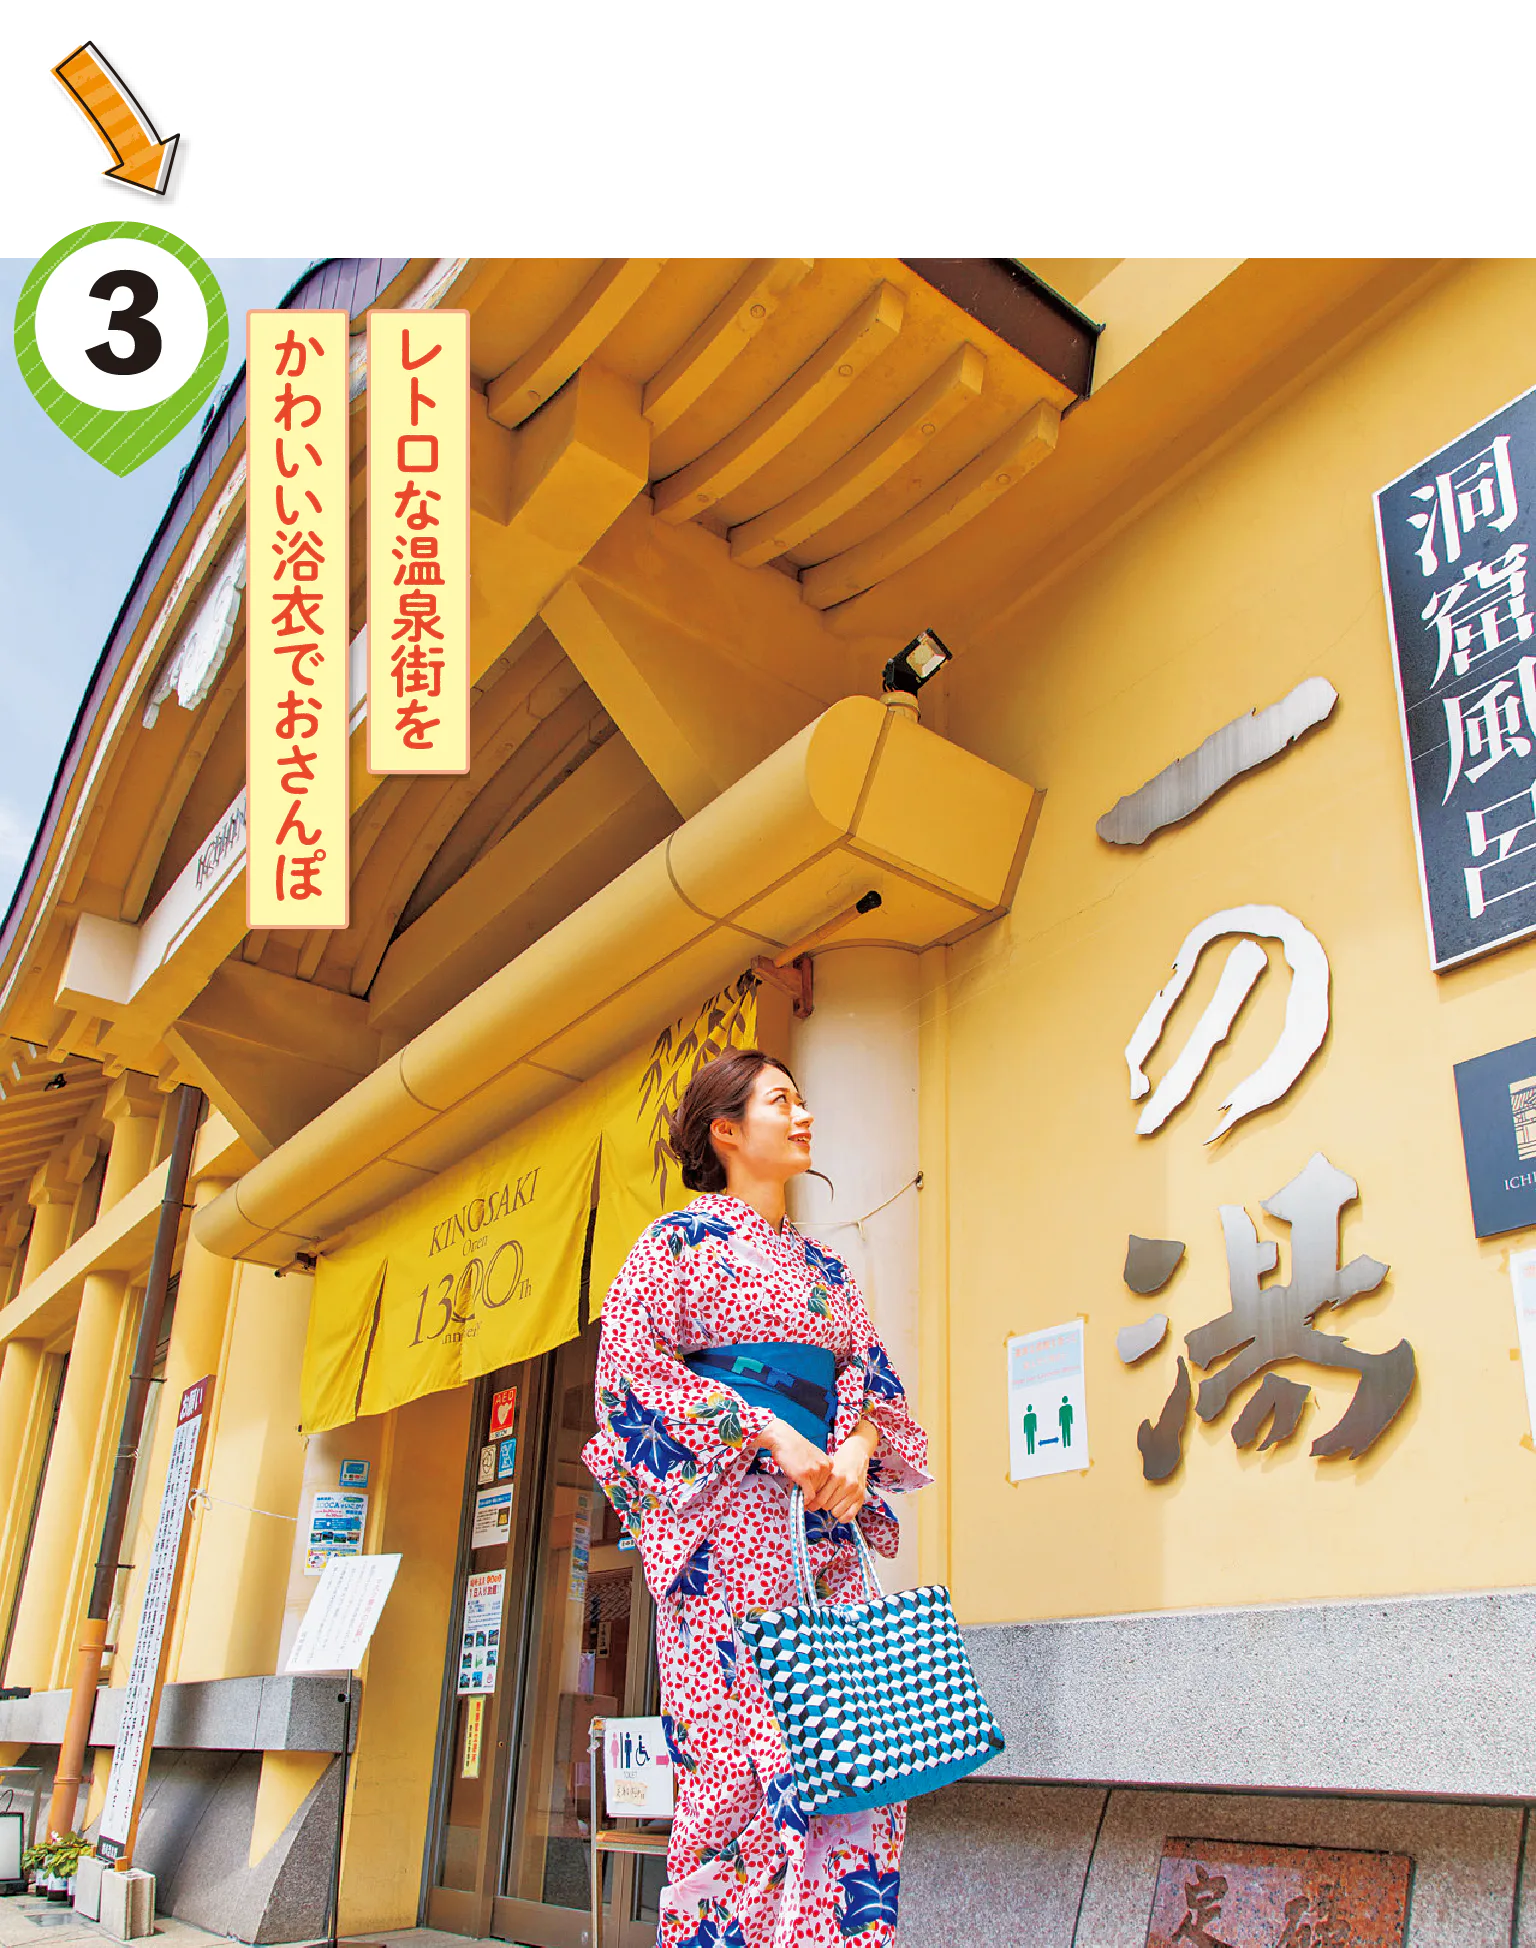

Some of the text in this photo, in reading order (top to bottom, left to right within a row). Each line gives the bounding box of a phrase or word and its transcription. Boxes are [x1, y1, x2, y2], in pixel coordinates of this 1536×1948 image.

[1405, 434, 1536, 920] 洞窟風呂
[428, 1167, 541, 1258] KINOSAKI
[496, 1390, 514, 1404] AED
